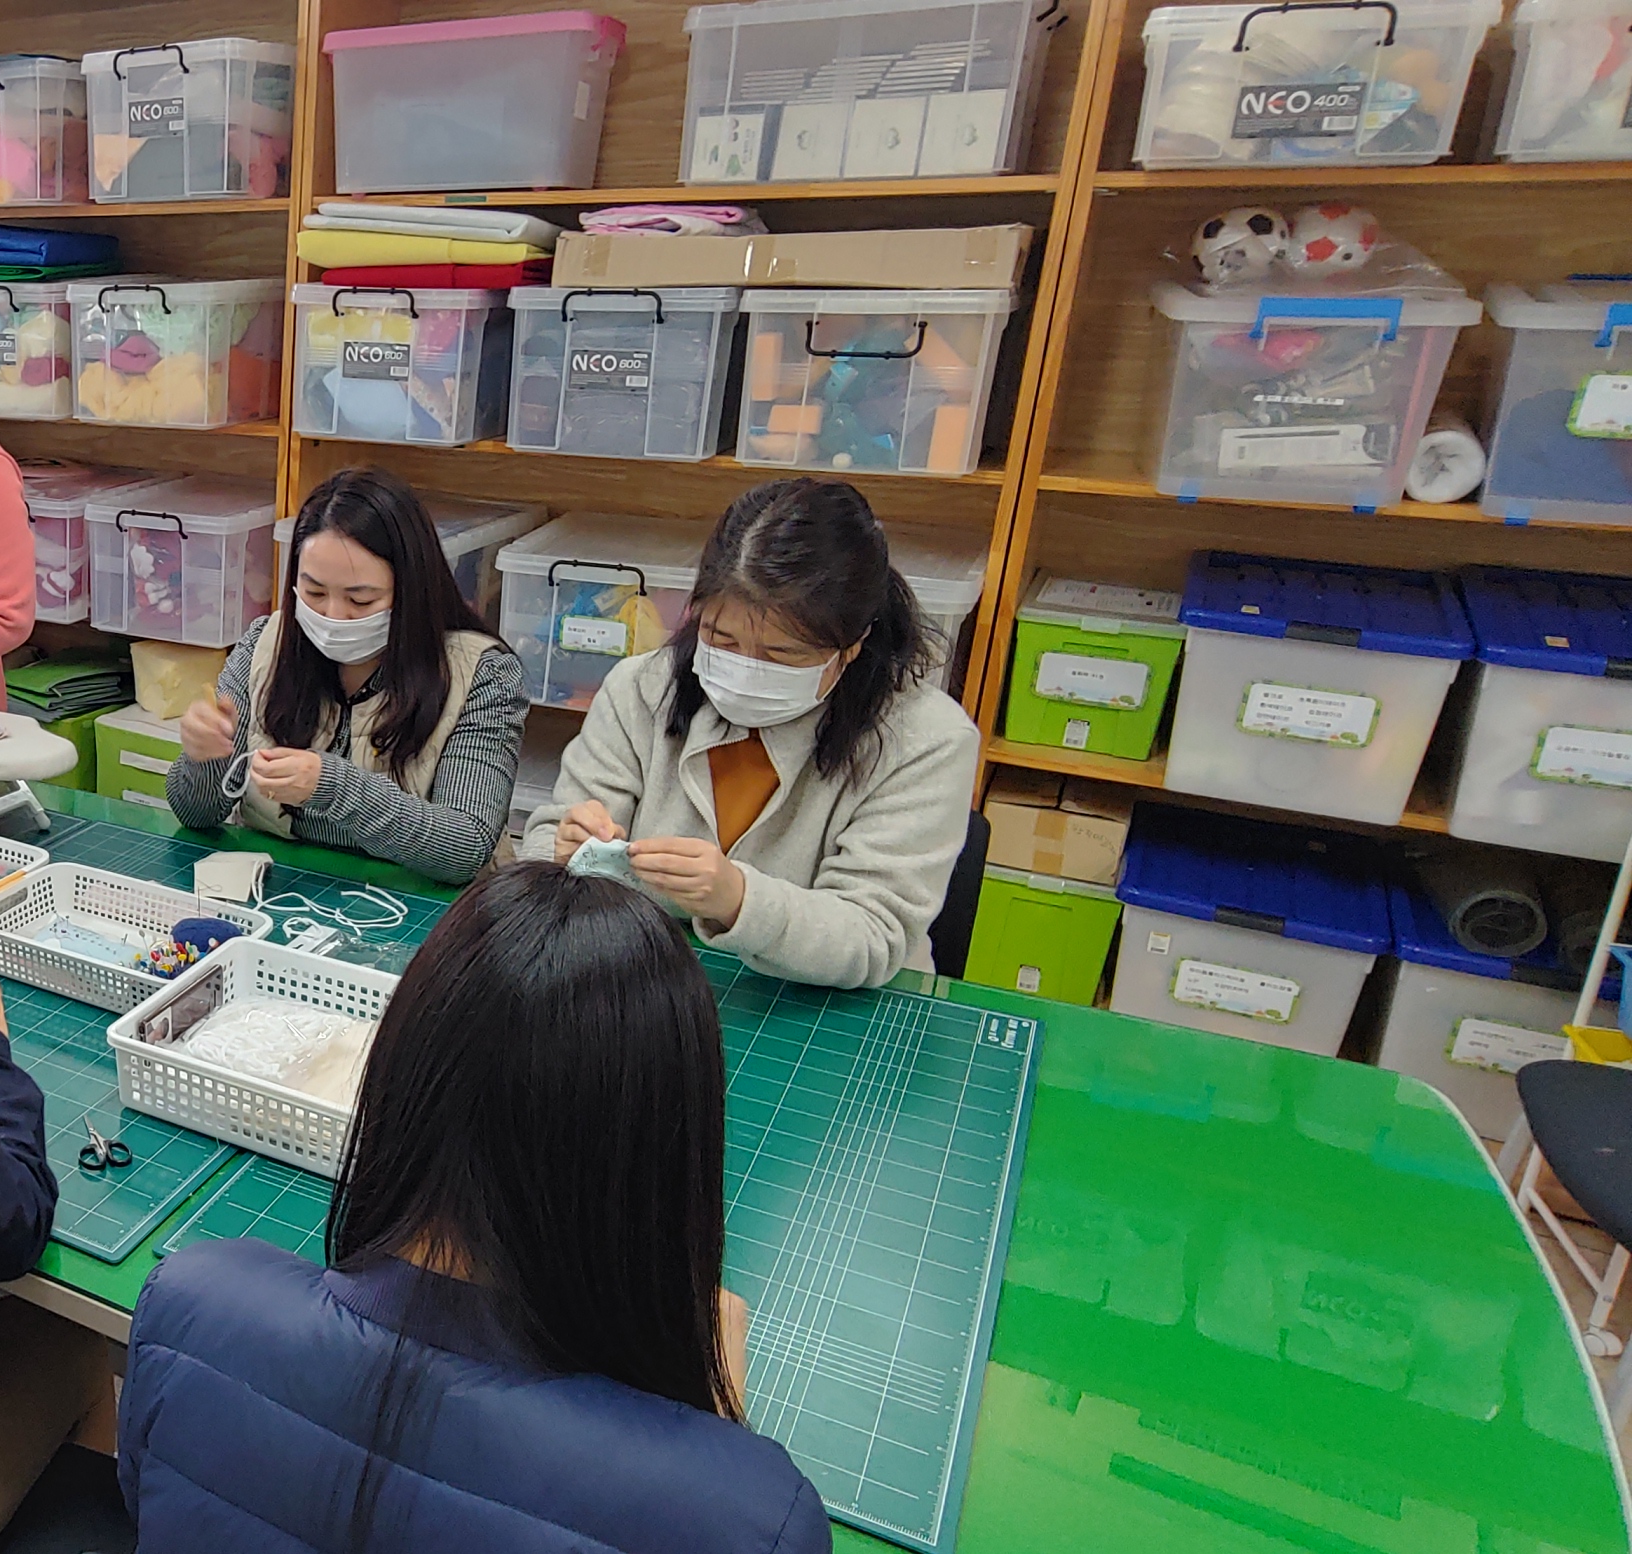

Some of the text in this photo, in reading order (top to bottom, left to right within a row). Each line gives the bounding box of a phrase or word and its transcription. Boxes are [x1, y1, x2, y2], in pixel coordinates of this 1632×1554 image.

[1241, 90, 1349, 114] NEO 400
[130, 103, 162, 121] NEO
[346, 346, 383, 363] NEO
[572, 354, 642, 372] NEO 600
